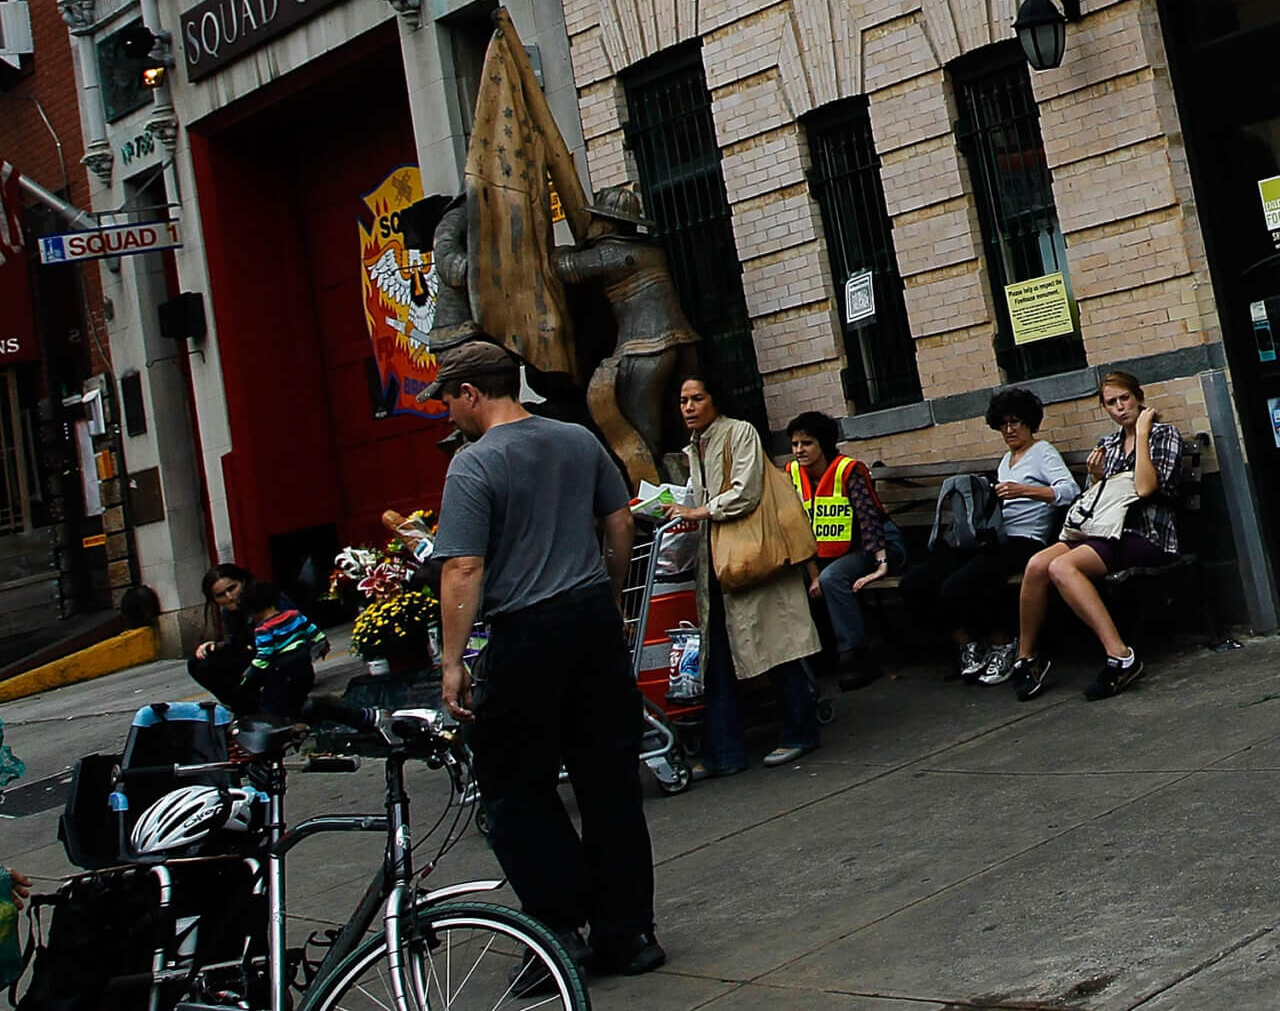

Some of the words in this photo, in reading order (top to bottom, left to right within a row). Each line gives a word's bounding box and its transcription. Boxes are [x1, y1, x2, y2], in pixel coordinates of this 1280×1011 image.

[69, 229, 157, 256] SQUAD
[168, 225, 178, 242] 1
[816, 505, 852, 517] SLOPE
[816, 525, 845, 536] COOP
